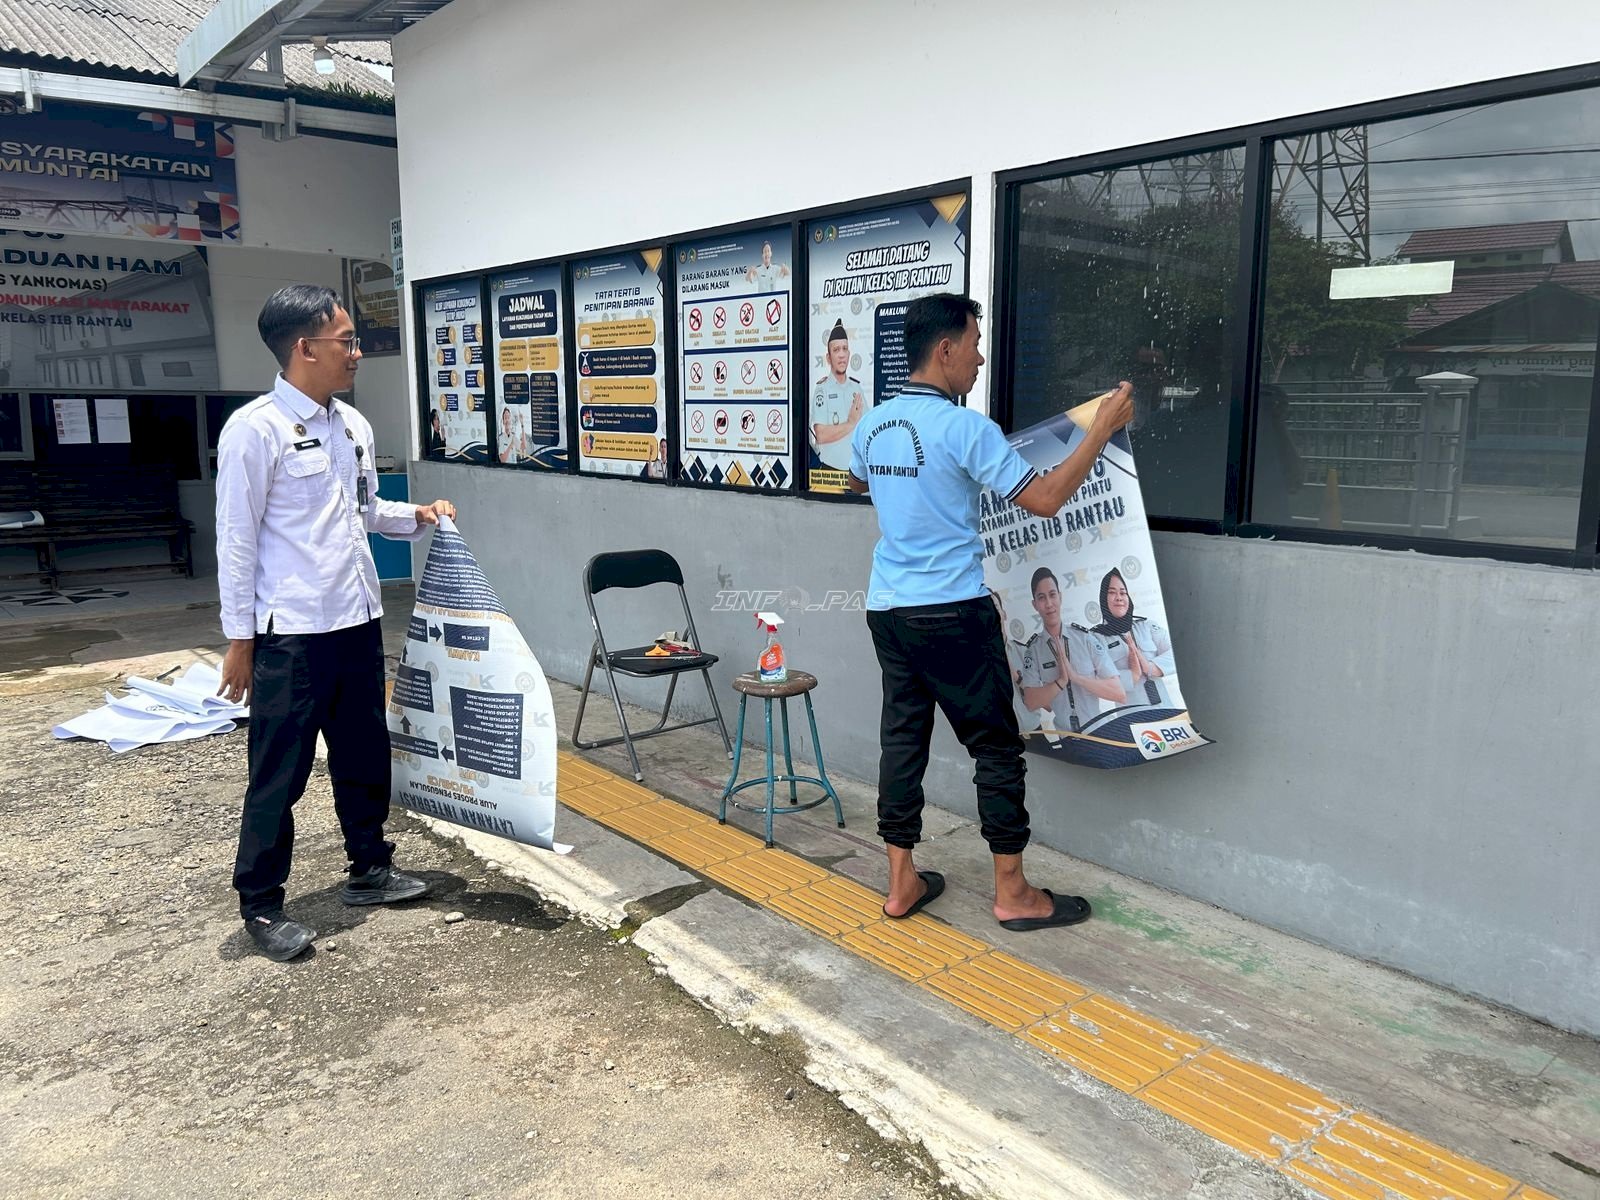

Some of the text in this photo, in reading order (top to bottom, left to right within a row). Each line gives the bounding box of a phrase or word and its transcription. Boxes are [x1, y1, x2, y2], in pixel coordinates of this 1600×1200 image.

[1, 141, 211, 178] SYARAKATAN
[0, 158, 120, 183] MUNTAI
[106, 255, 183, 276] HAM
[845, 240, 931, 272] SELAMAT DATANG
[10, 273, 108, 292] YANKOMAS)
[681, 265, 748, 282] BARANG BARANG YANG
[823, 263, 953, 298] DI RUTAN KELAS IIB RANTAU
[594, 286, 641, 300] TATA TERTIB
[681, 280, 730, 294] DILARANG MASUK
[86, 297, 191, 314] MASYARAKAT
[508, 294, 546, 313] JADWAL
[583, 297, 655, 313] PENITIPAN BARANG
[1, 312, 133, 328] KELAS IIB RANTAU
[871, 419, 897, 438] BINAAN
[1081, 477, 1112, 500] PINTU
[998, 523, 1040, 553] KELAS
[1041, 515, 1063, 542] IIB
[1064, 496, 1126, 533] RANTAU
[1160, 726, 1191, 743] BRI
[409, 781, 499, 811] ALUR PROSES PENGUSULAN
[398, 791, 516, 837] LAYANAN INTEGRASI
